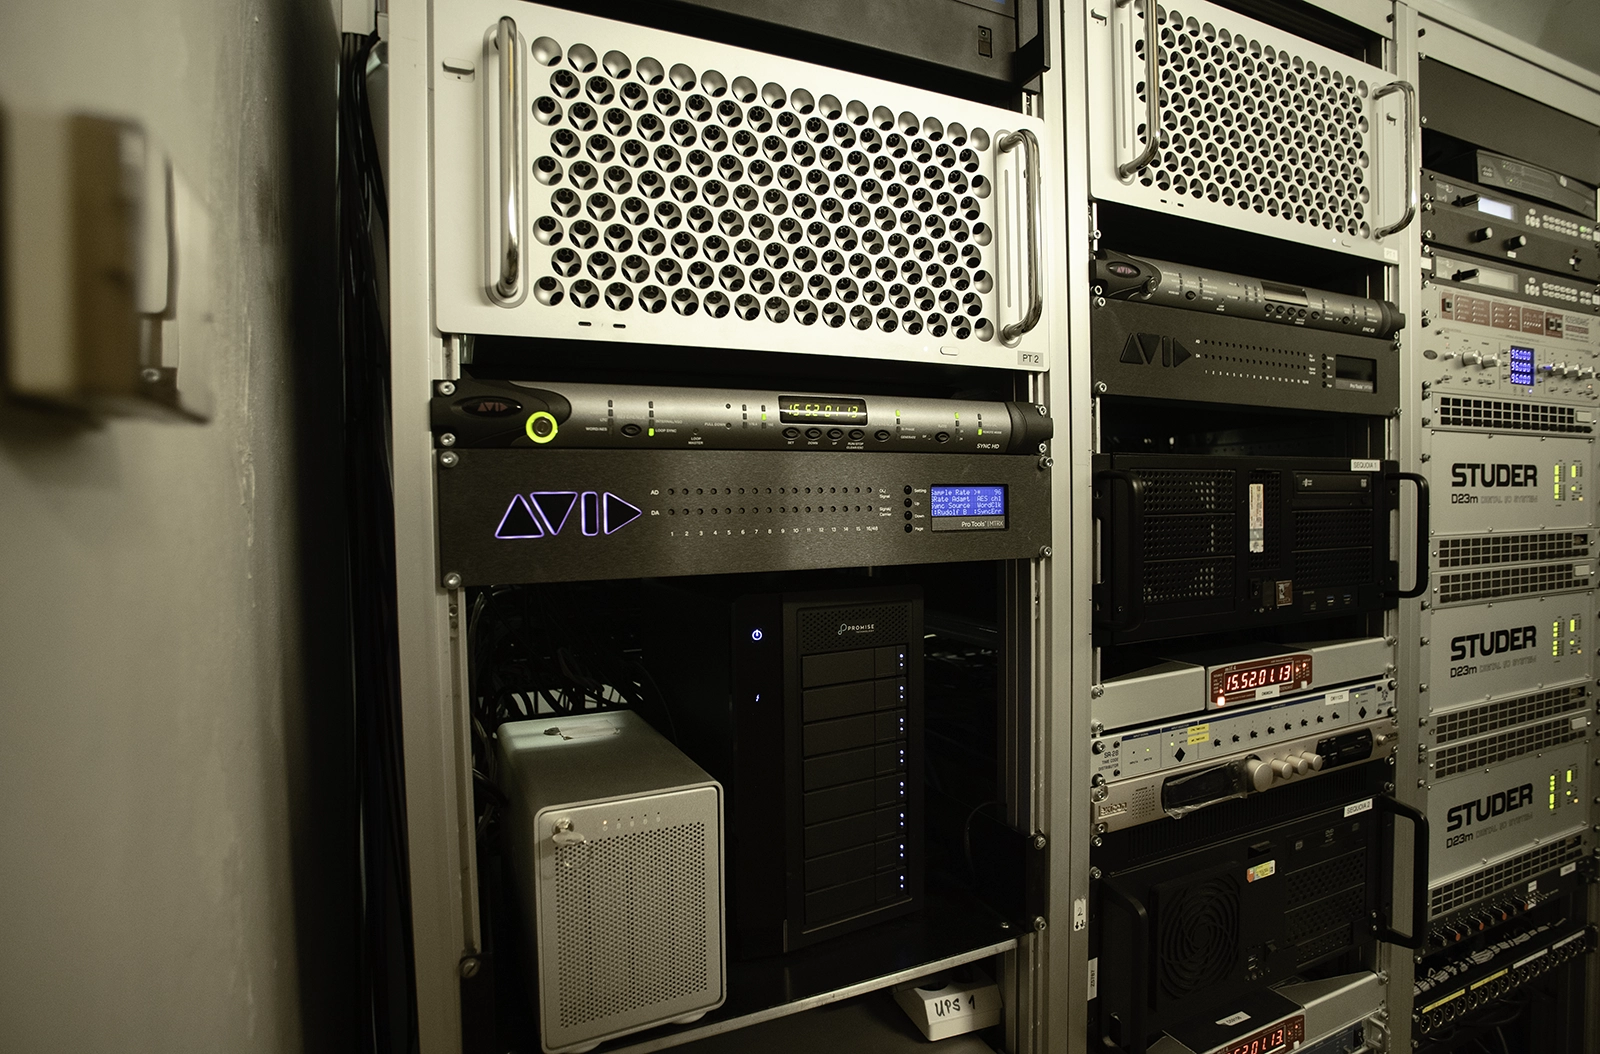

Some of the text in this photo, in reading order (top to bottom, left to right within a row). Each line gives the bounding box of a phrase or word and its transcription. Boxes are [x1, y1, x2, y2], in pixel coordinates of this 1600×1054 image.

[1022, 354, 1039, 363] PT 2
[1452, 463, 1537, 487] STUDER
[1451, 494, 1478, 504] D23m
[495, 492, 642, 539] AVID
[1451, 626, 1536, 661] STUDER
[1451, 665, 1477, 678] D23m
[1347, 803, 1366, 814] SEQUOIA
[1447, 782, 1533, 832] STUDER
[1446, 833, 1473, 848] D23m
[935, 994, 975, 1017] UPS 1
